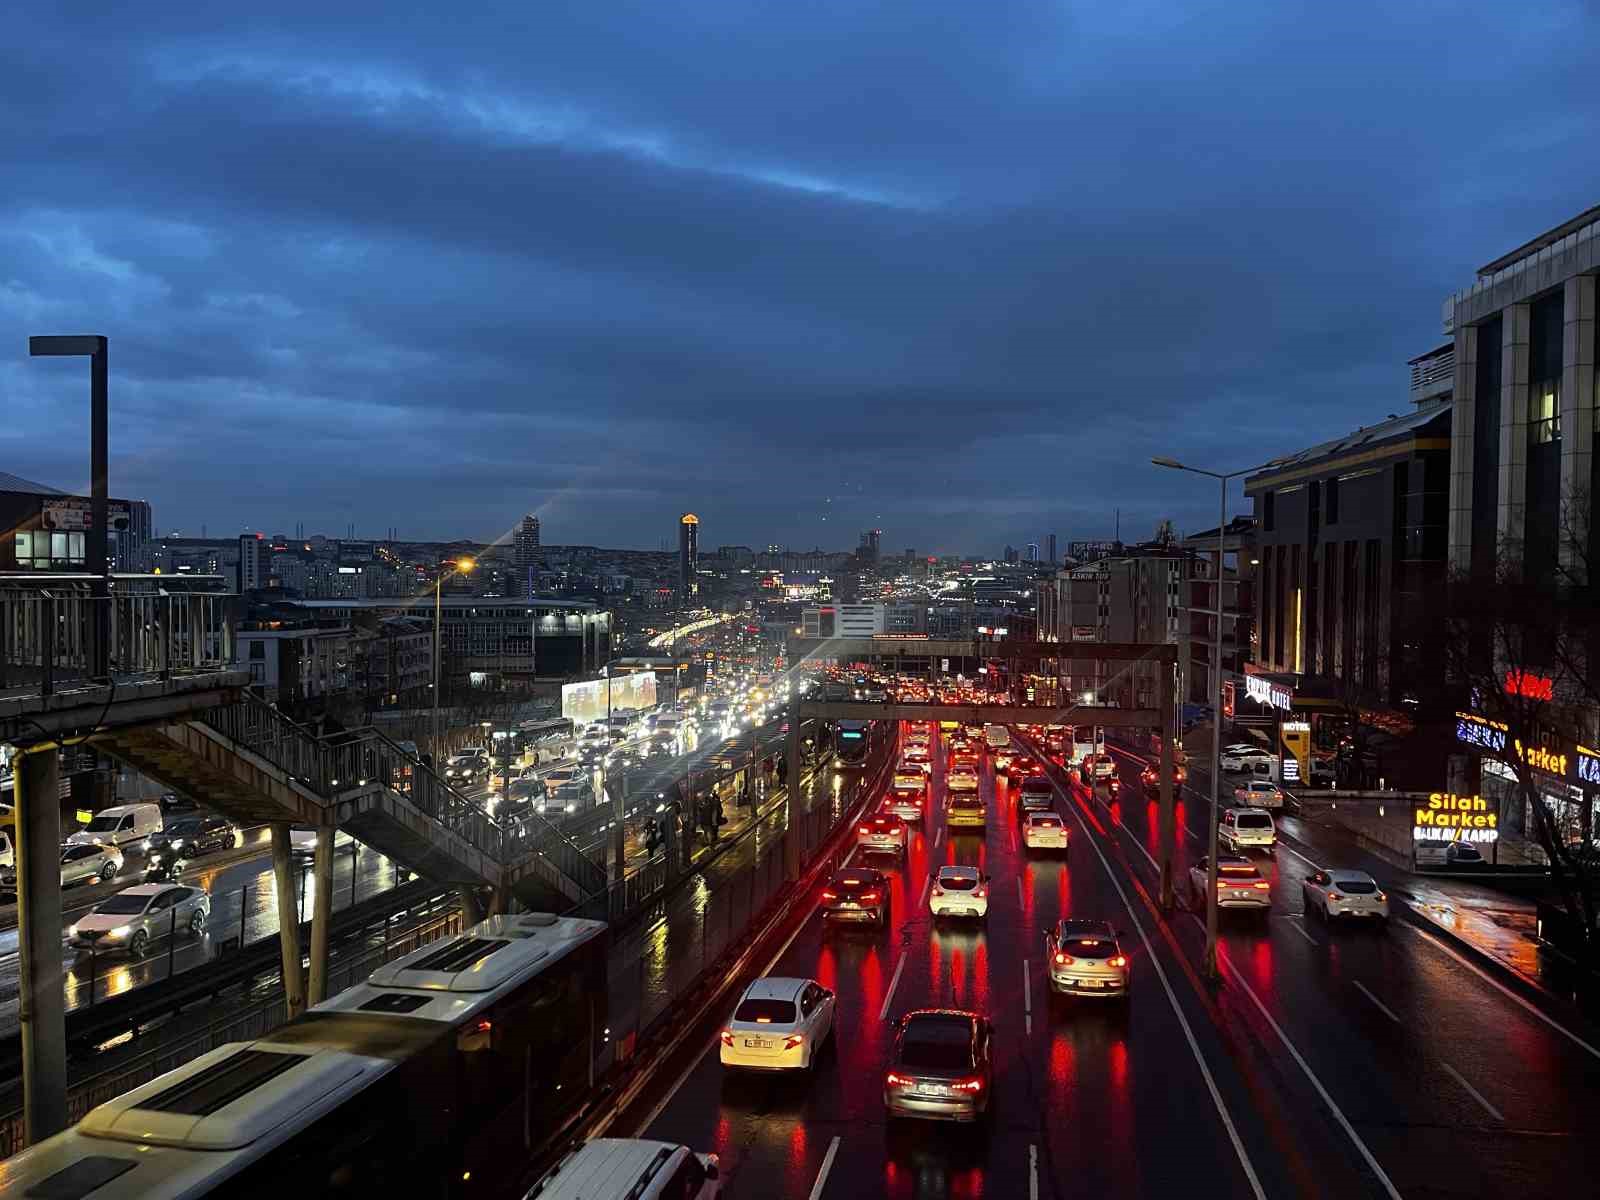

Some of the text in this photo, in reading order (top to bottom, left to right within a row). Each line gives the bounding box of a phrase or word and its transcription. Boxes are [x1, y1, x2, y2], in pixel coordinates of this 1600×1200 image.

[1246, 675, 1292, 711] EMPIRE HOTEL
[1429, 793, 1487, 811] Silah
[1416, 809, 1497, 828] Market
